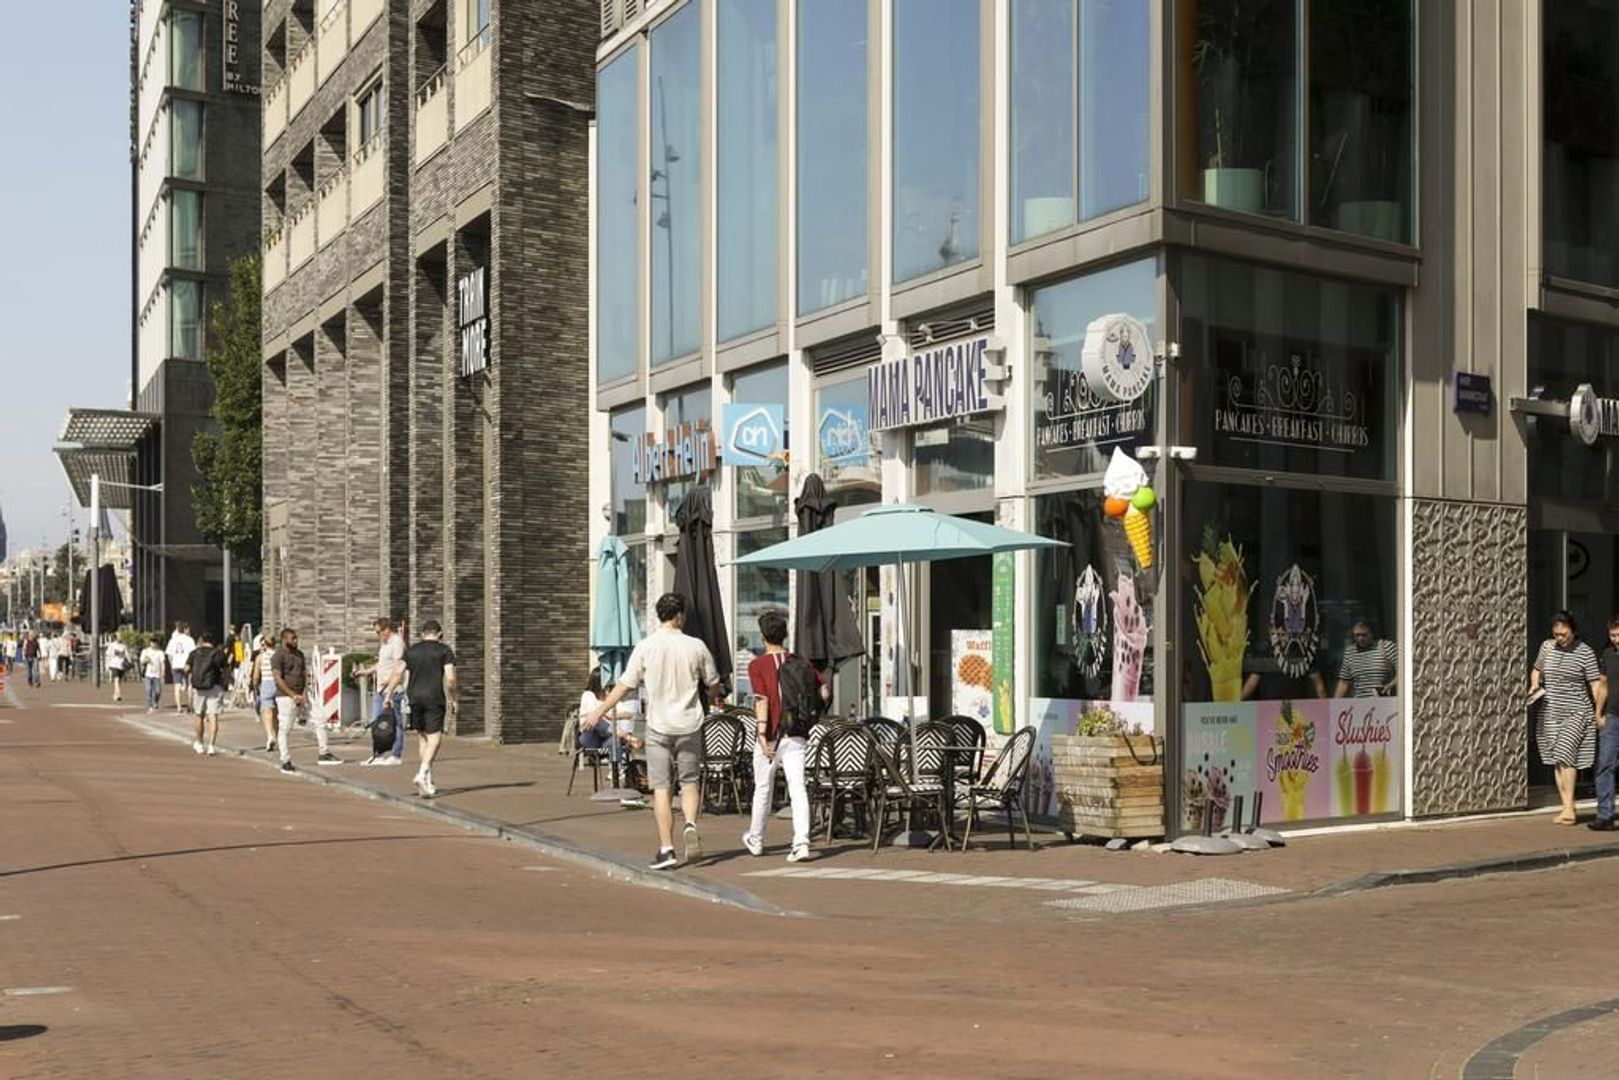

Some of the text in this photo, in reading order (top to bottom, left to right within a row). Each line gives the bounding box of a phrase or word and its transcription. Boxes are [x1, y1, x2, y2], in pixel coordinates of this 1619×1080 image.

[227, 72, 241, 80] BY
[461, 317, 487, 378] MORE
[868, 338, 988, 431] MAMA PANCAKE
[1101, 365, 1152, 397] MAMA PANCAKE
[1214, 408, 1265, 435] PANCAKES
[1271, 416, 1324, 442] BREAKFAST
[632, 420, 710, 486] Albert Heijn
[1335, 705, 1398, 744] Slushies
[1266, 741, 1320, 782] Smoothies
